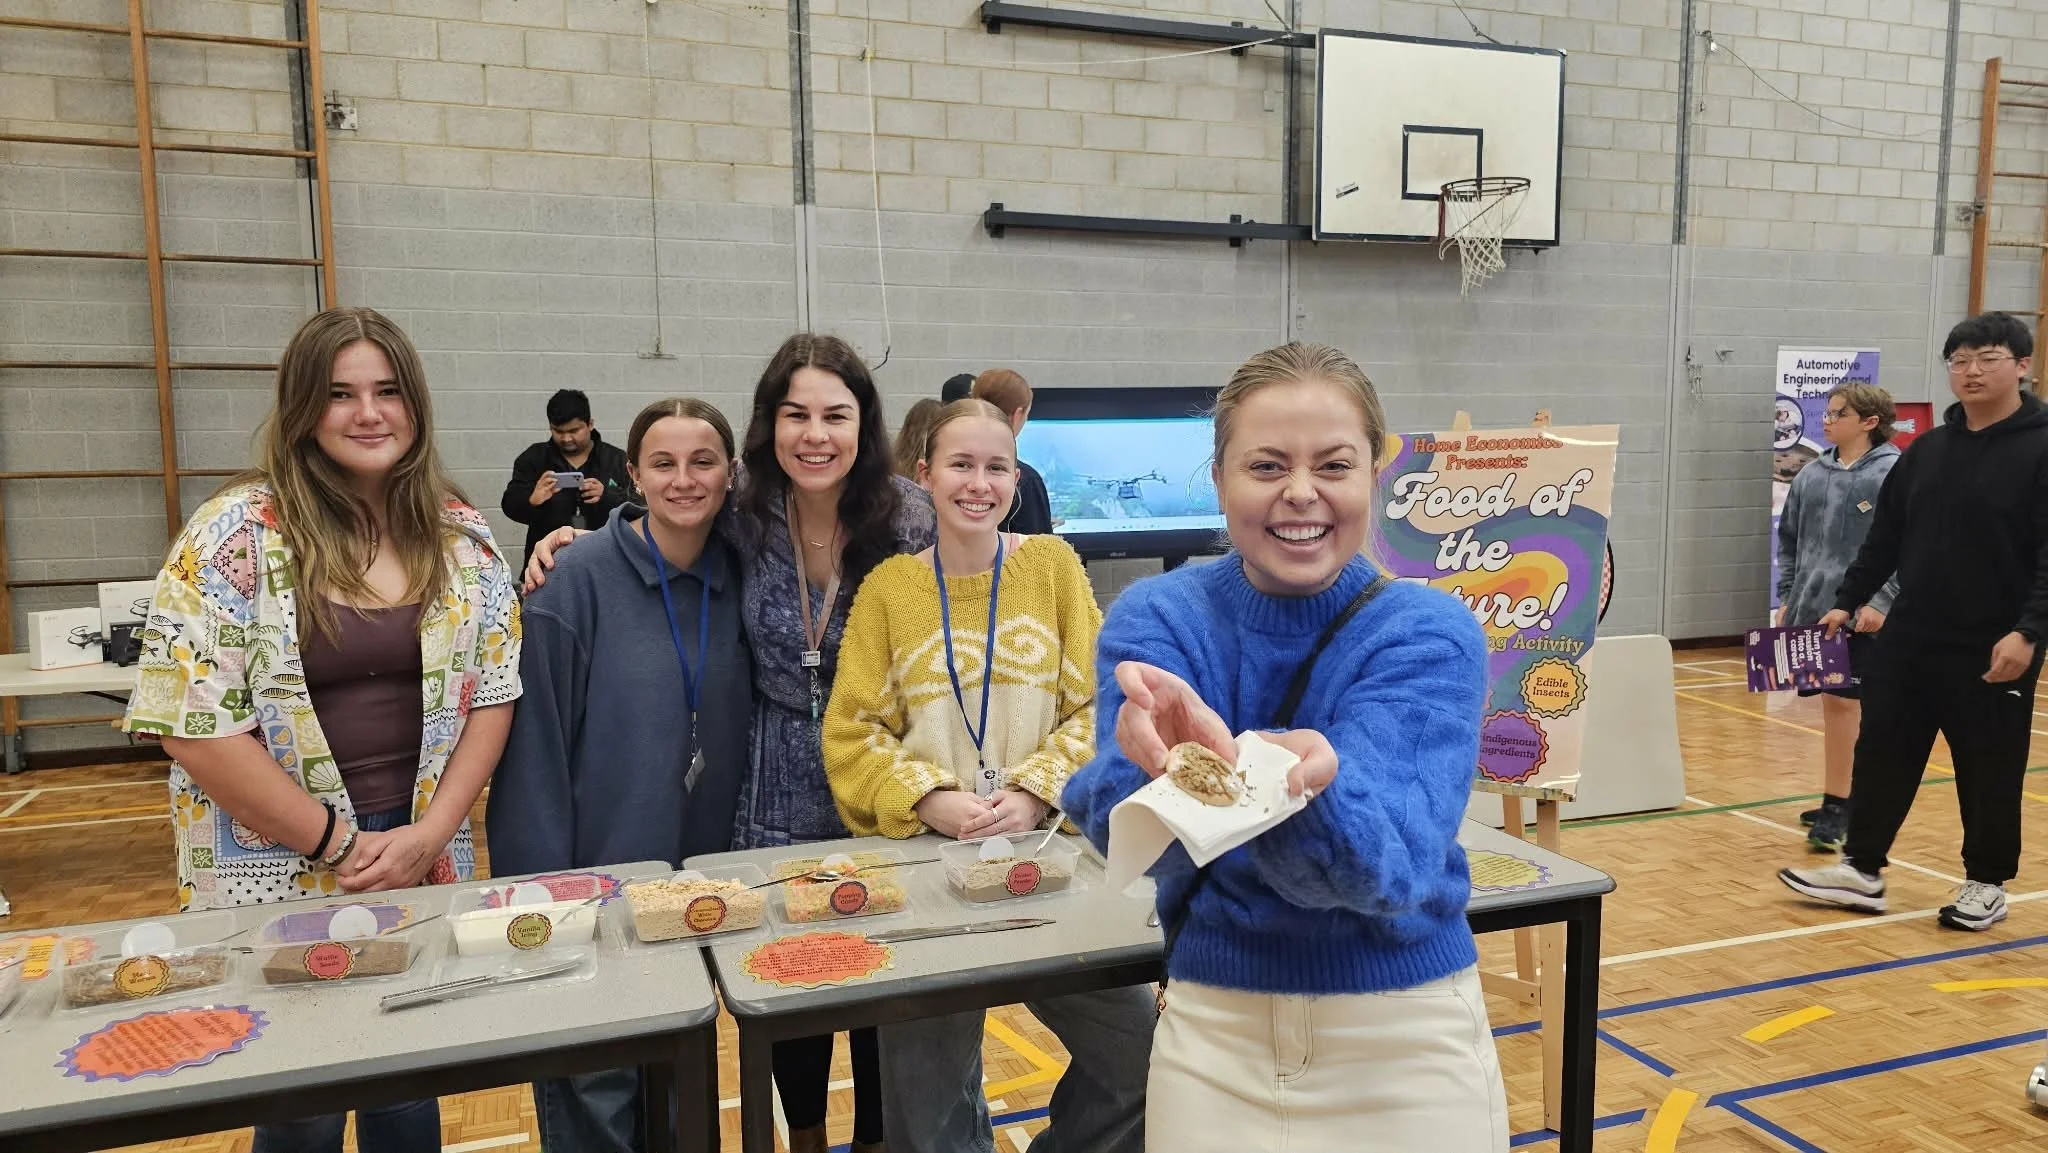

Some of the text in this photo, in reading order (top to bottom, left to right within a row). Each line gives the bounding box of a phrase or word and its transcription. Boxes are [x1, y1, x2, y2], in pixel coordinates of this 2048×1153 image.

[1796, 359, 1861, 370] Automotive
[1783, 373, 1848, 388] Engineering
[1796, 389, 1828, 400] Techn
[1414, 435, 1564, 453] Home Economics
[1445, 454, 1529, 470] Presents:
[1385, 468, 1594, 520] Food of
[1434, 528, 1514, 572] the
[1394, 576, 1569, 631] ure!
[1513, 633, 1585, 657] Activity
[1797, 635, 1806, 652] into
[1803, 629, 1814, 661] passion
[1813, 630, 1824, 671] Turn your
[1536, 677, 1569, 688] Edible
[1532, 687, 1570, 698] Insects
[1482, 732, 1537, 747] Indigenous
